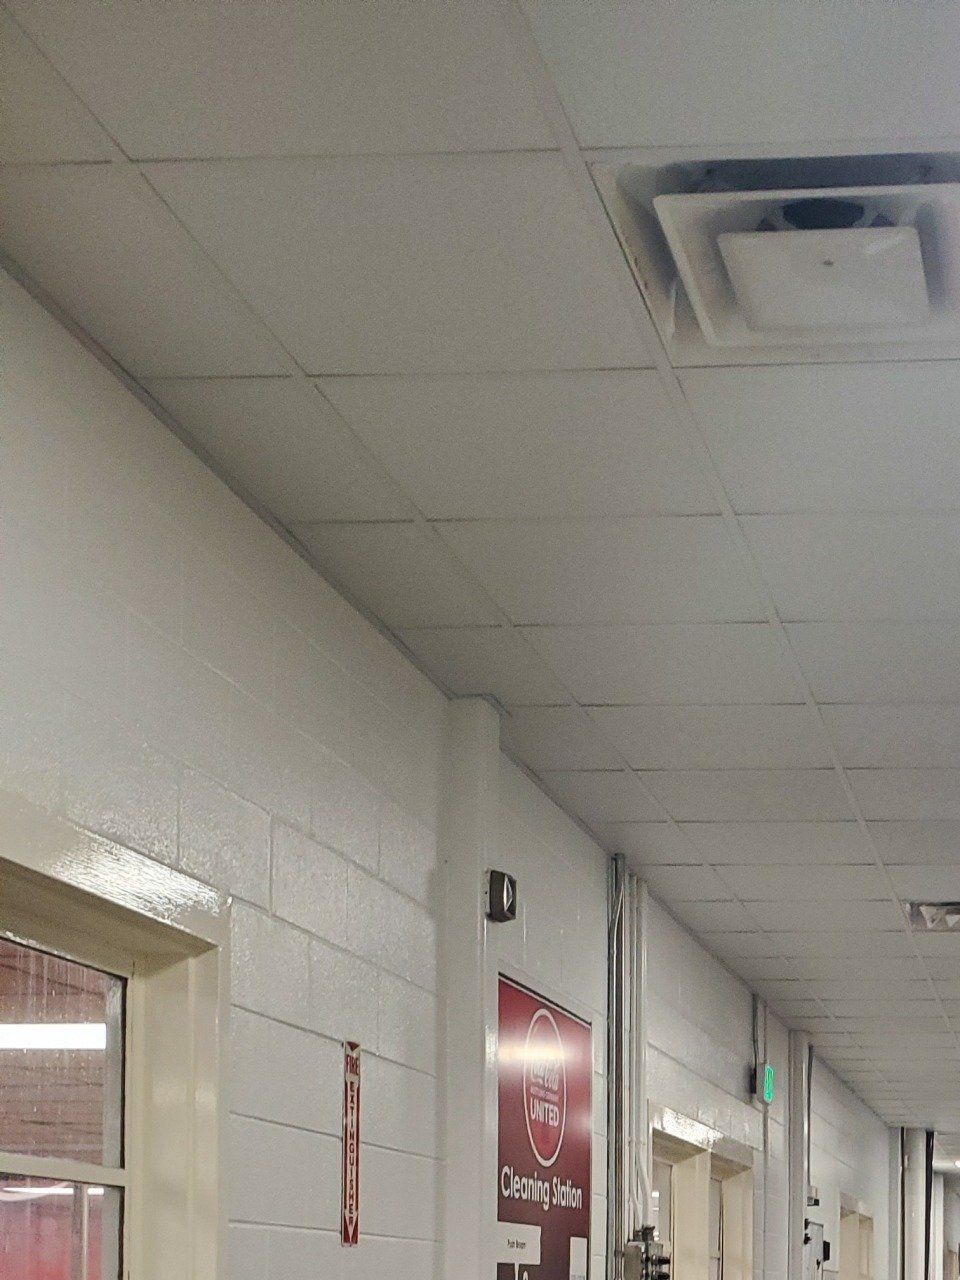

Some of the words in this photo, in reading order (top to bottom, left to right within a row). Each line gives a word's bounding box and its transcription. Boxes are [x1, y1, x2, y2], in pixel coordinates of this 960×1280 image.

[345, 1053, 359, 1076] FIRE
[530, 1097, 559, 1127] UNITED
[348, 1081, 356, 1225] EXTINGUISHER
[501, 1165, 550, 1211] Cleaning
[552, 1175, 583, 1210] Station
